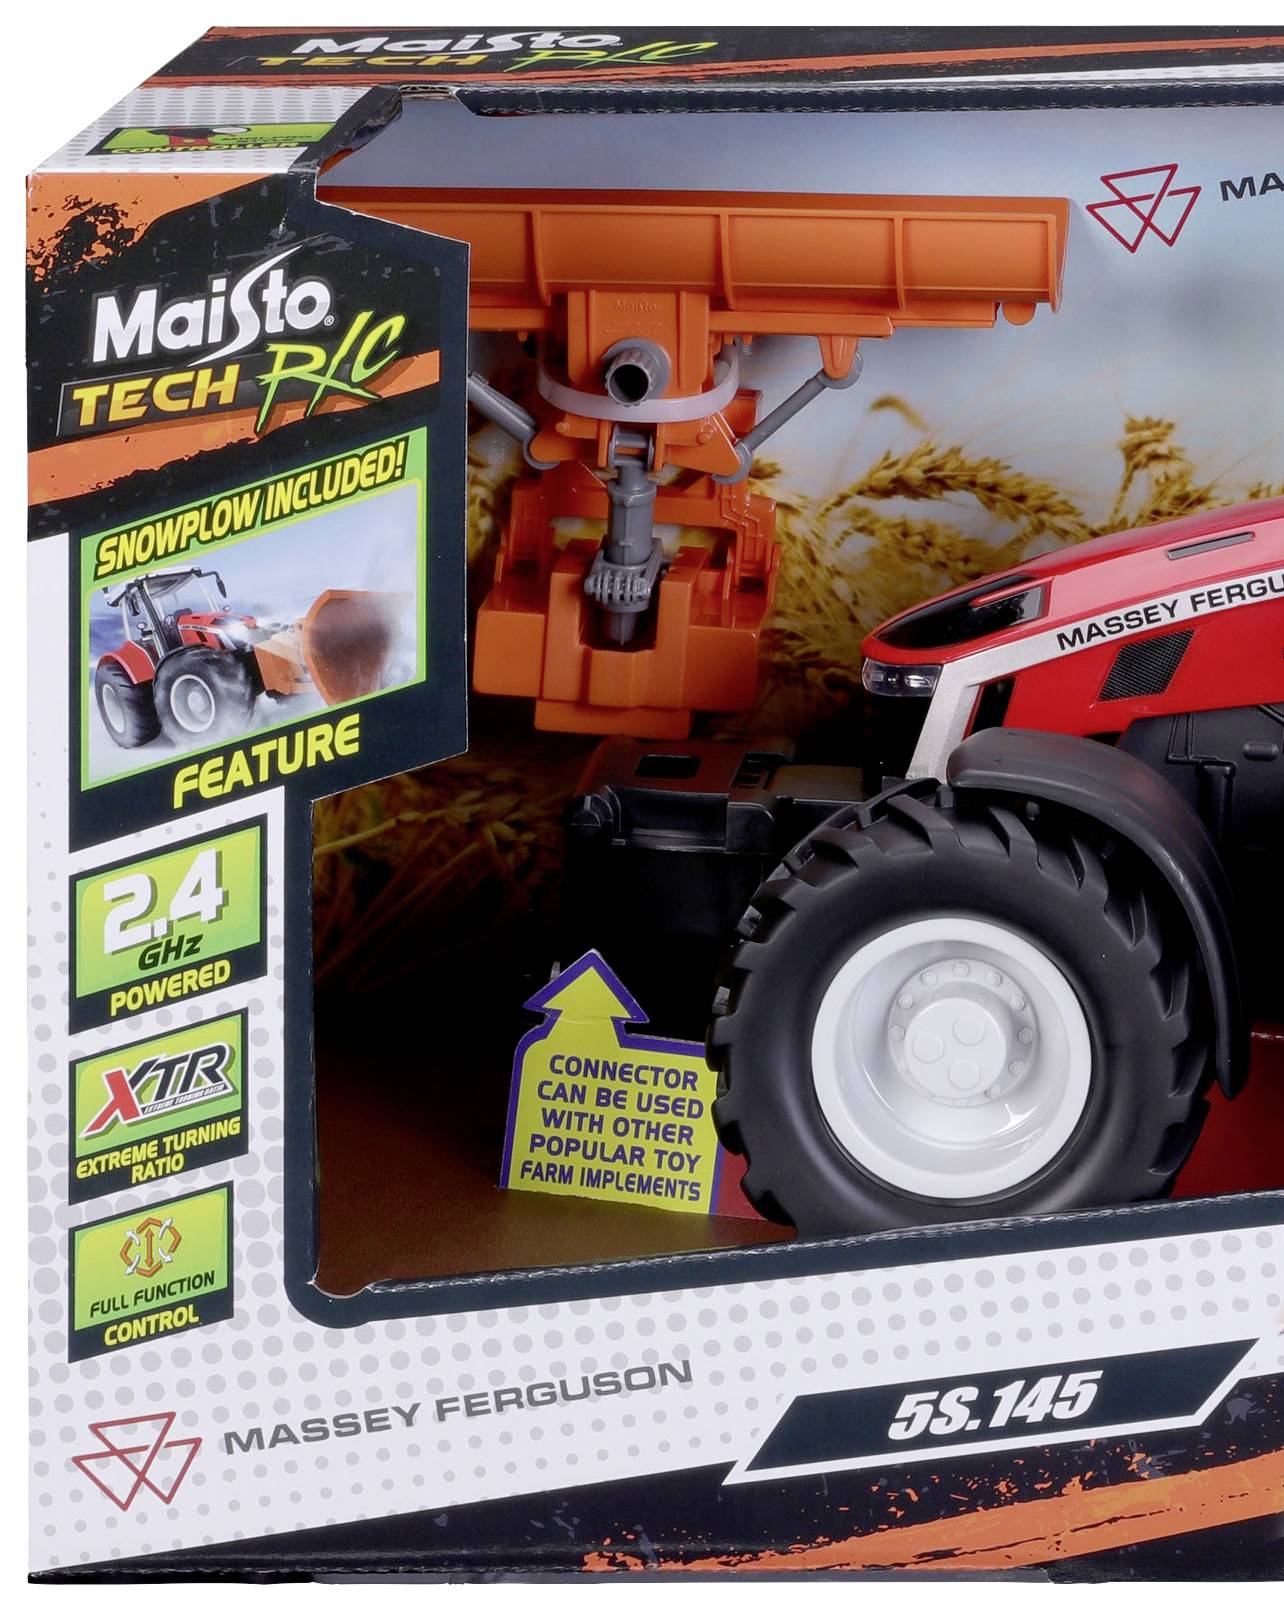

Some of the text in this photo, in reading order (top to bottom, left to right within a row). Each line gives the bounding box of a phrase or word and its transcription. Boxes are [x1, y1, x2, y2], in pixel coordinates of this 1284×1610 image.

[255, 40, 719, 72] TECH R/C
[72, 311, 406, 433] TECH R/C
[97, 441, 405, 575] SNOWPLOW INCLUDED!
[1057, 598, 1180, 651] MASSEY
[173, 712, 360, 809] FEATURE
[103, 848, 225, 954] 2.4
[138, 934, 203, 971] GHz
[110, 959, 231, 1017] POWERED
[80, 1043, 232, 1137] XTR
[549, 1054, 699, 1092] CONNECTOR
[537, 1081, 704, 1119] CAN BE USED
[76, 1116, 241, 1179] EXTREME TURNING
[541, 1107, 694, 1146] WITH OTHER
[131, 1153, 184, 1184] RATIO
[529, 1133, 702, 1173] POPULAR TOY
[520, 1160, 701, 1202] FARM IMPLEMENTS
[90, 1270, 215, 1318] FULL FUNCTION
[104, 1304, 199, 1346] CONTROL
[224, 1360, 693, 1456] MASSEY FERGUSON
[887, 1370, 1104, 1441] 5S.145
